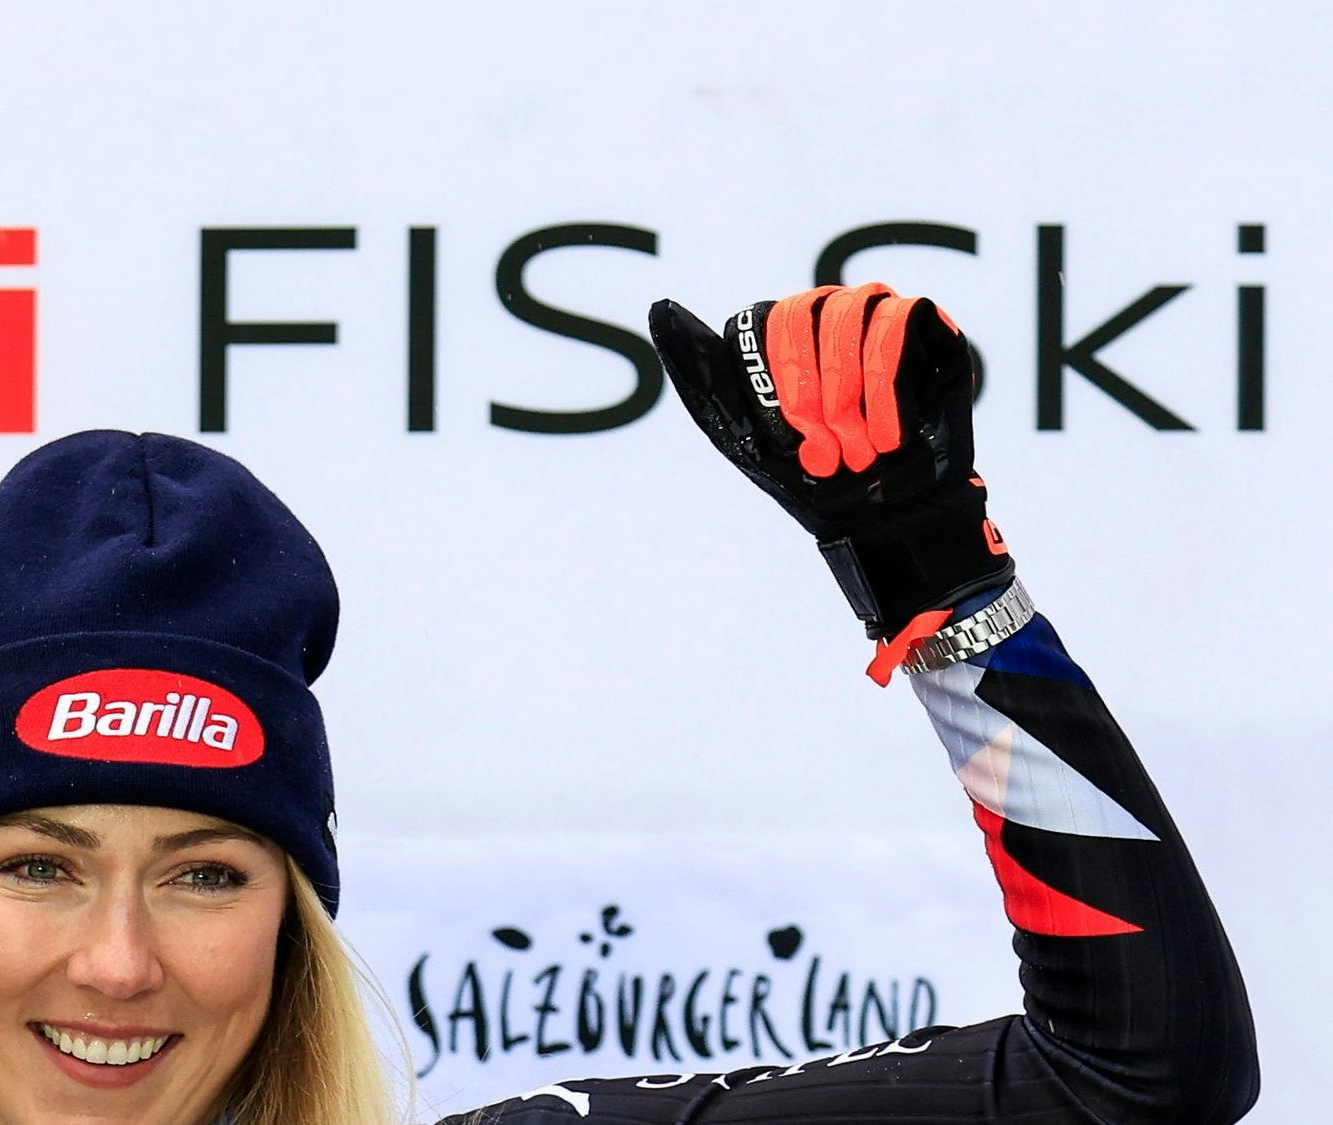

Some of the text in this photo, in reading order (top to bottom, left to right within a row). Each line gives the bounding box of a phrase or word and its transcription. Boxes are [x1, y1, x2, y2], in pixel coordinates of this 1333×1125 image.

[198, 222, 664, 434] FIS
[737, 304, 781, 407] reusc
[47, 692, 238, 750] Barilla
